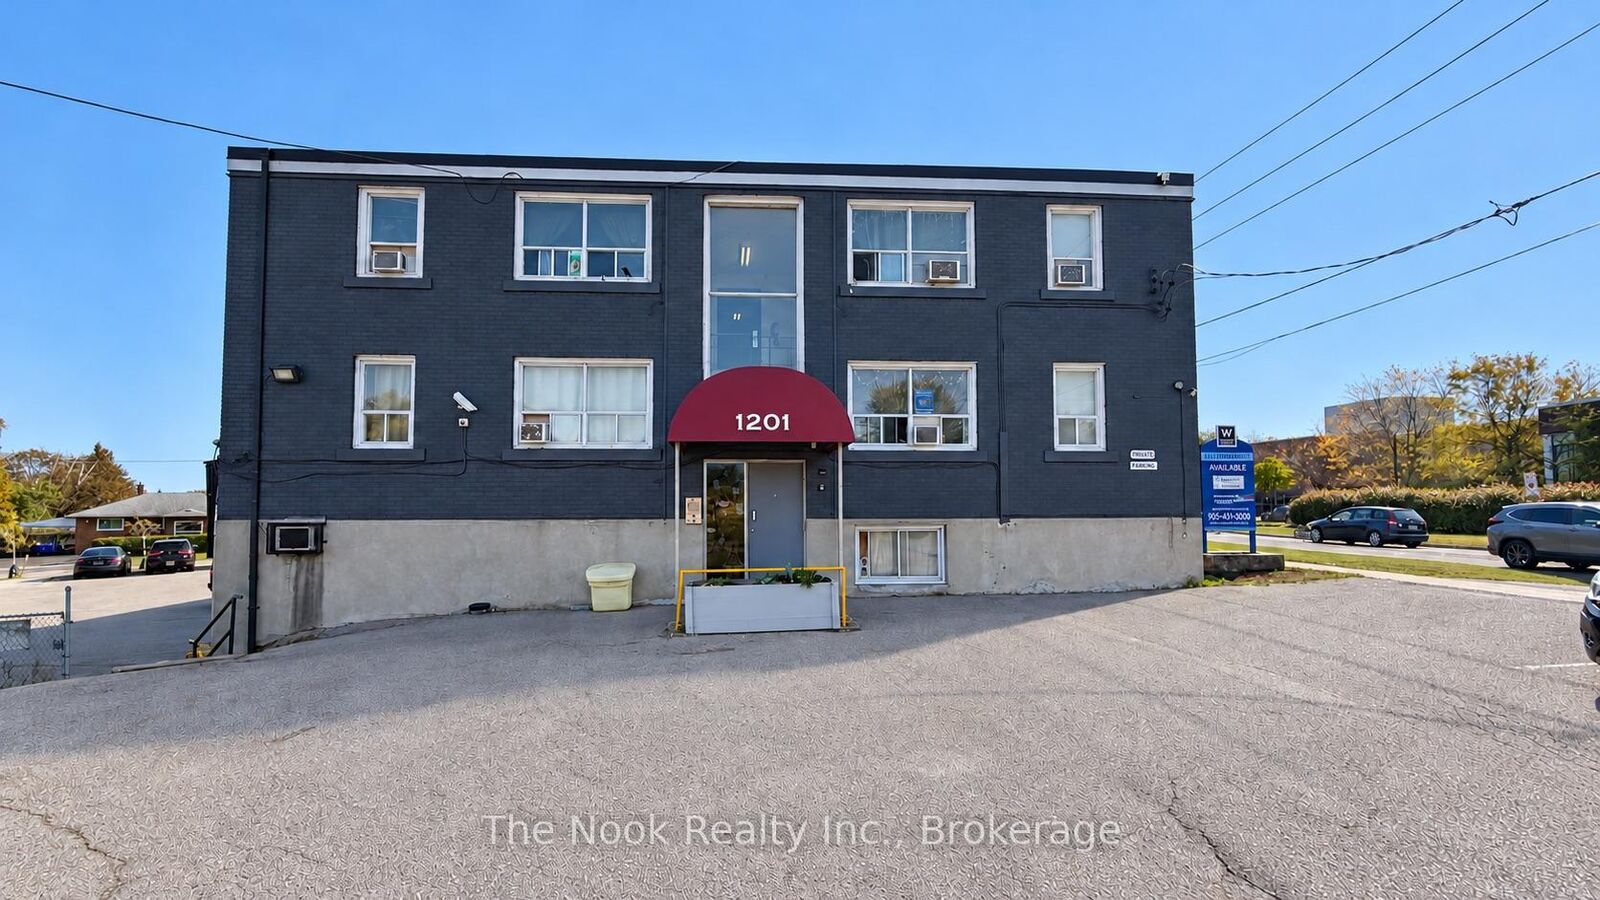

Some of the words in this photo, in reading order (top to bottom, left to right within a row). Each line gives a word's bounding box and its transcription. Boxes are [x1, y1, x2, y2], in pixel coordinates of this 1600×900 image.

[735, 413, 790, 431] 1201
[1220, 428, 1232, 438] W
[1209, 464, 1247, 472] AVAILABLE
